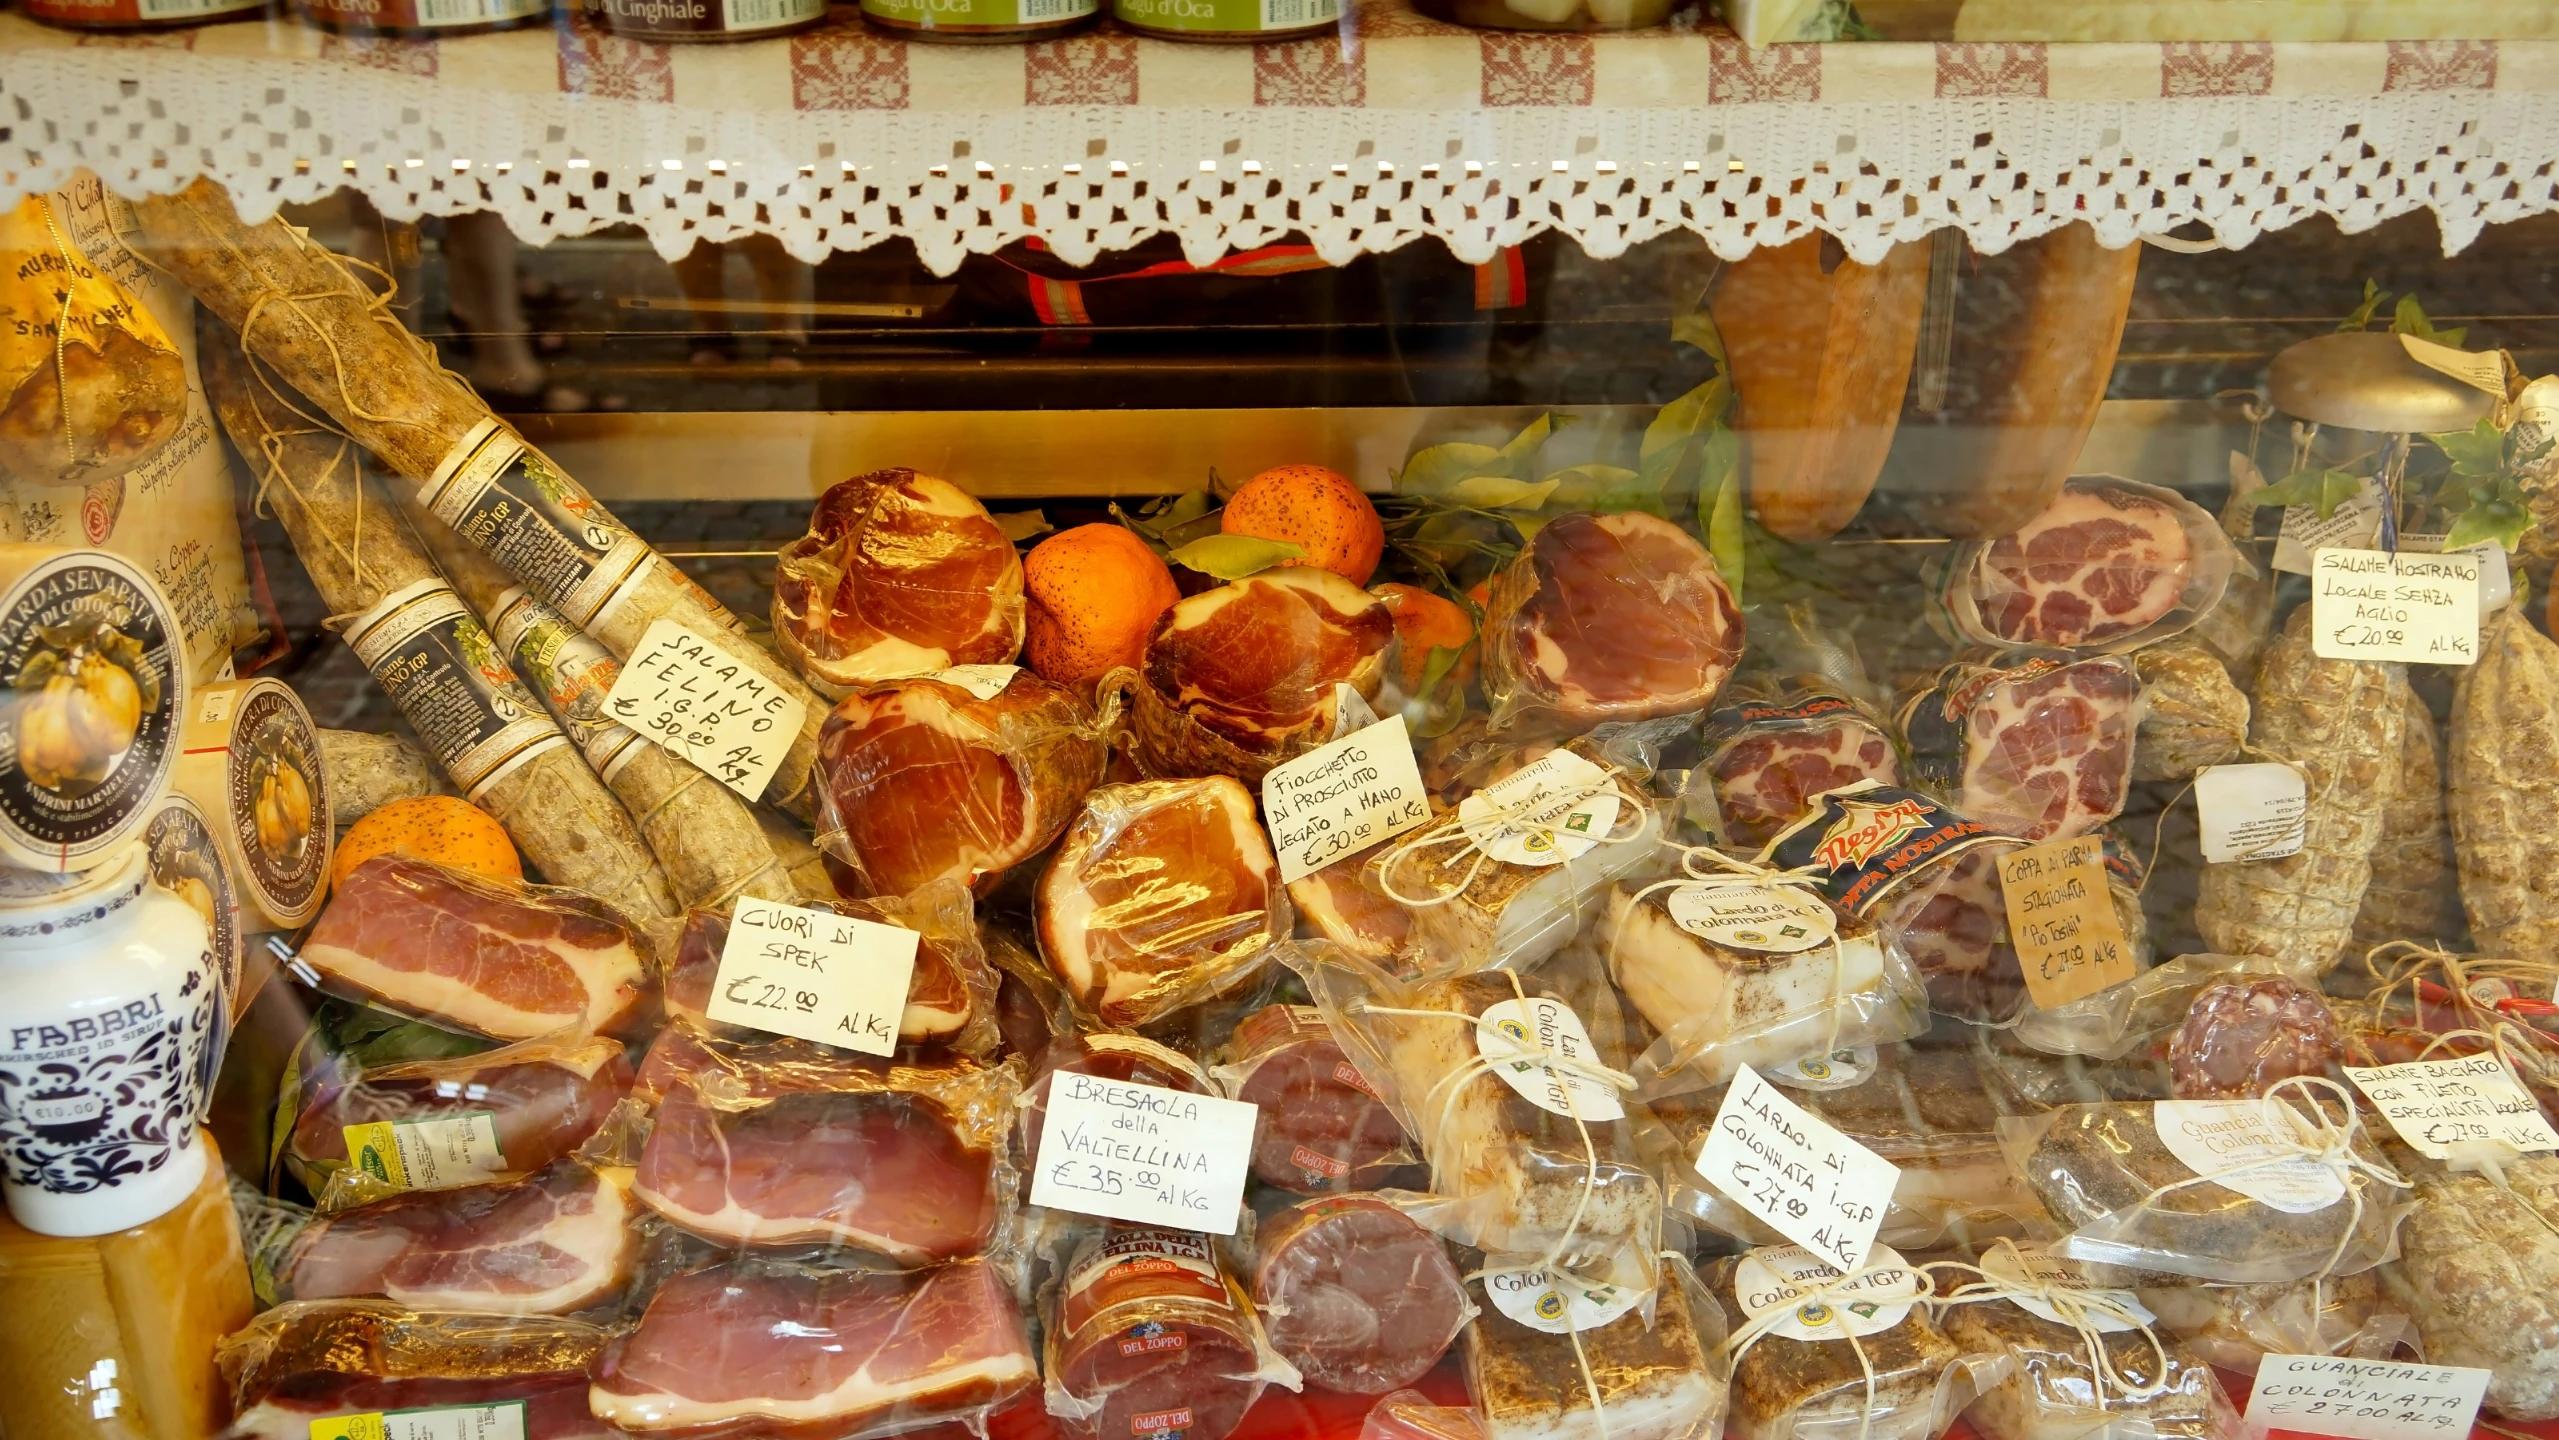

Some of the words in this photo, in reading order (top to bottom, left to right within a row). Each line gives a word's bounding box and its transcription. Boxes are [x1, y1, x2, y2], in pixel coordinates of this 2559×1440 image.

[617, 0, 706, 24] Cinghiale
[15, 318, 60, 337] SAN
[490, 499, 512, 524] IGP
[2324, 578, 2387, 600] LOCALE
[65, 569, 156, 633] SENAPATA
[2429, 635, 2448, 654] AL
[408, 651, 430, 673] IGP
[662, 635, 786, 714] SALAME
[637, 651, 773, 732] FELINO
[453, 726, 482, 750] ITALIANA
[74, 808, 124, 839] TIPICO
[1279, 816, 1331, 852] LEGATO
[1343, 807, 1354, 824] A
[1685, 913, 1788, 930] Colonnata
[1707, 903, 1769, 917] Lardo
[759, 942, 829, 974] SPEK
[10, 992, 165, 1051] FABBRI
[837, 1011, 859, 1035] AL
[865, 1013, 892, 1043] KG
[1065, 1075, 1198, 1122] BRESAOLA
[1153, 1231, 1204, 1250] DELLA
[1811, 1224, 1832, 1249] AL
[1108, 1267, 1132, 1279] DEL
[1133, 1261, 1173, 1273] ZOPPO
[1863, 1270, 1904, 1288] IGP
[1122, 1340, 1145, 1355] DEL
[1146, 1336, 1183, 1350] ZOPPO
[2288, 1361, 2454, 1384] GUANCIALE
[2262, 1384, 2462, 1409] COLONNATA
[1134, 1416, 1169, 1430] ZOPPO
[1171, 1411, 1190, 1424] DEL
[2396, 1412, 2424, 1422] AL
